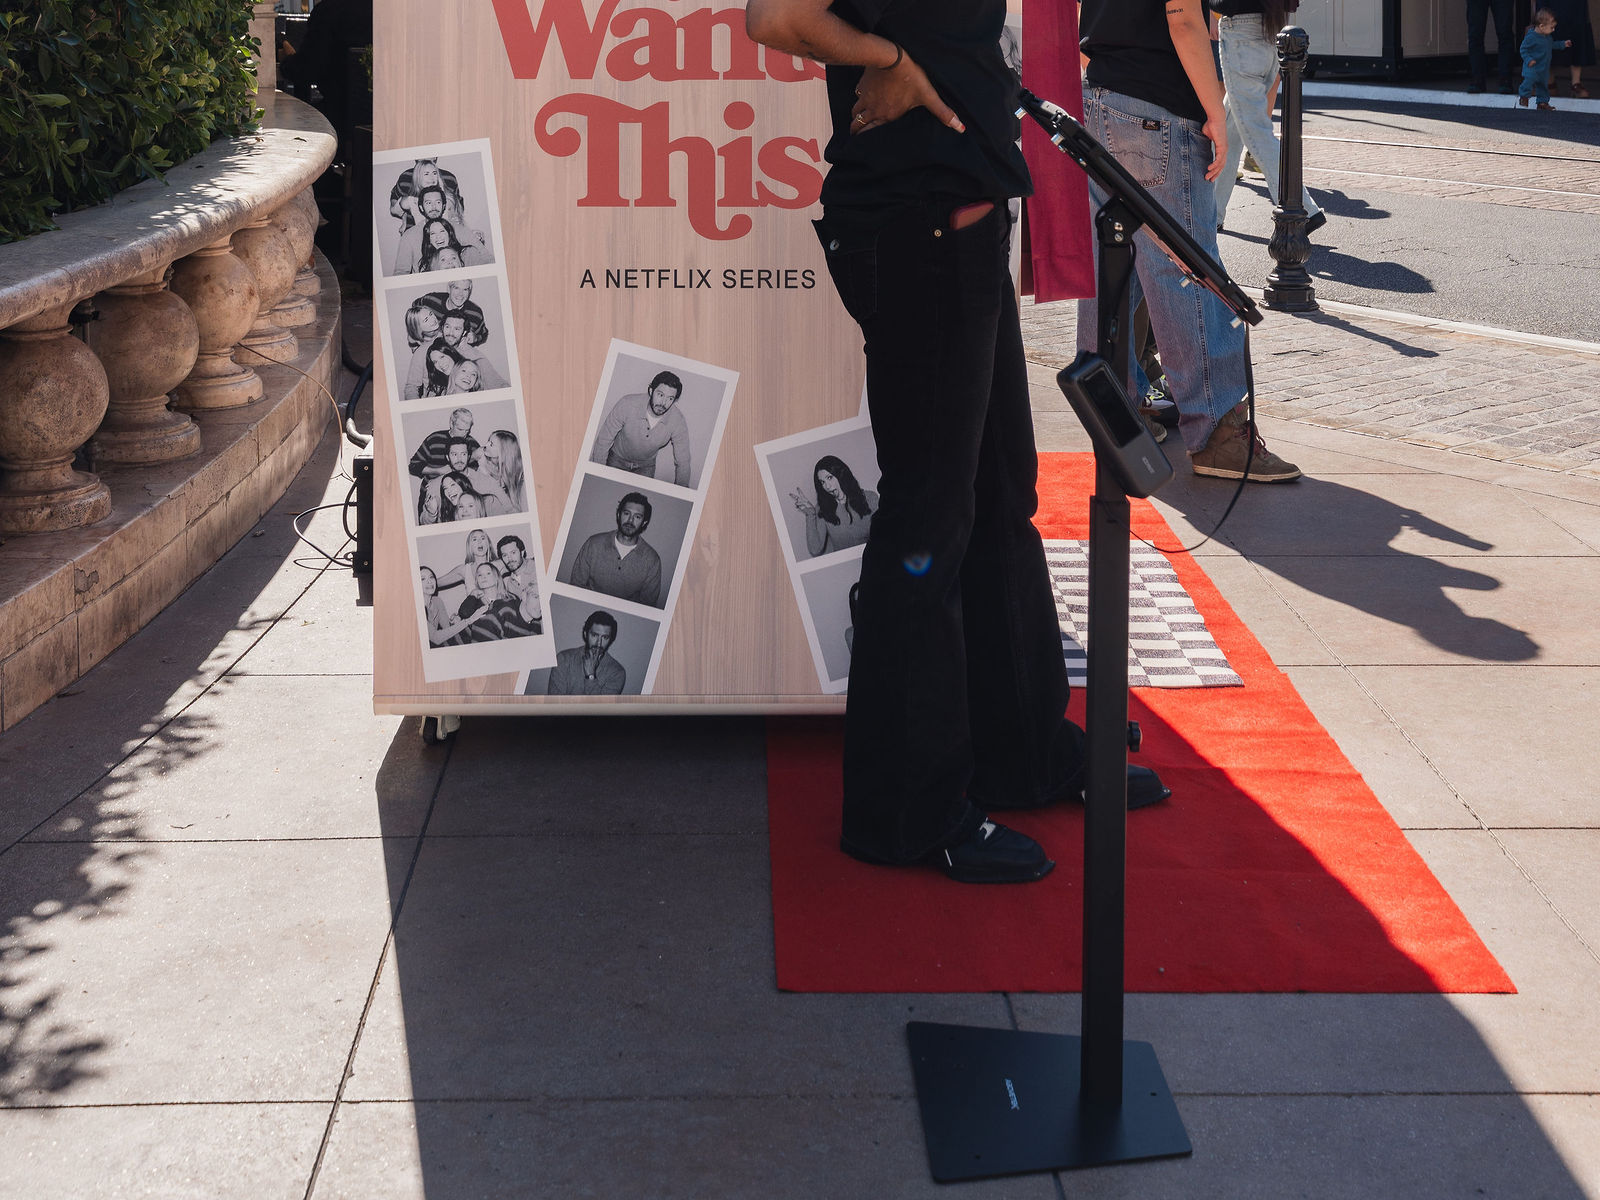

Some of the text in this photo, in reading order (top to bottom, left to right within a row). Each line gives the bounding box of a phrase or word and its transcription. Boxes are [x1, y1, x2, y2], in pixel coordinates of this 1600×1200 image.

[534, 92, 824, 241] This
[579, 268, 817, 290] A NETFLIX SERIES
